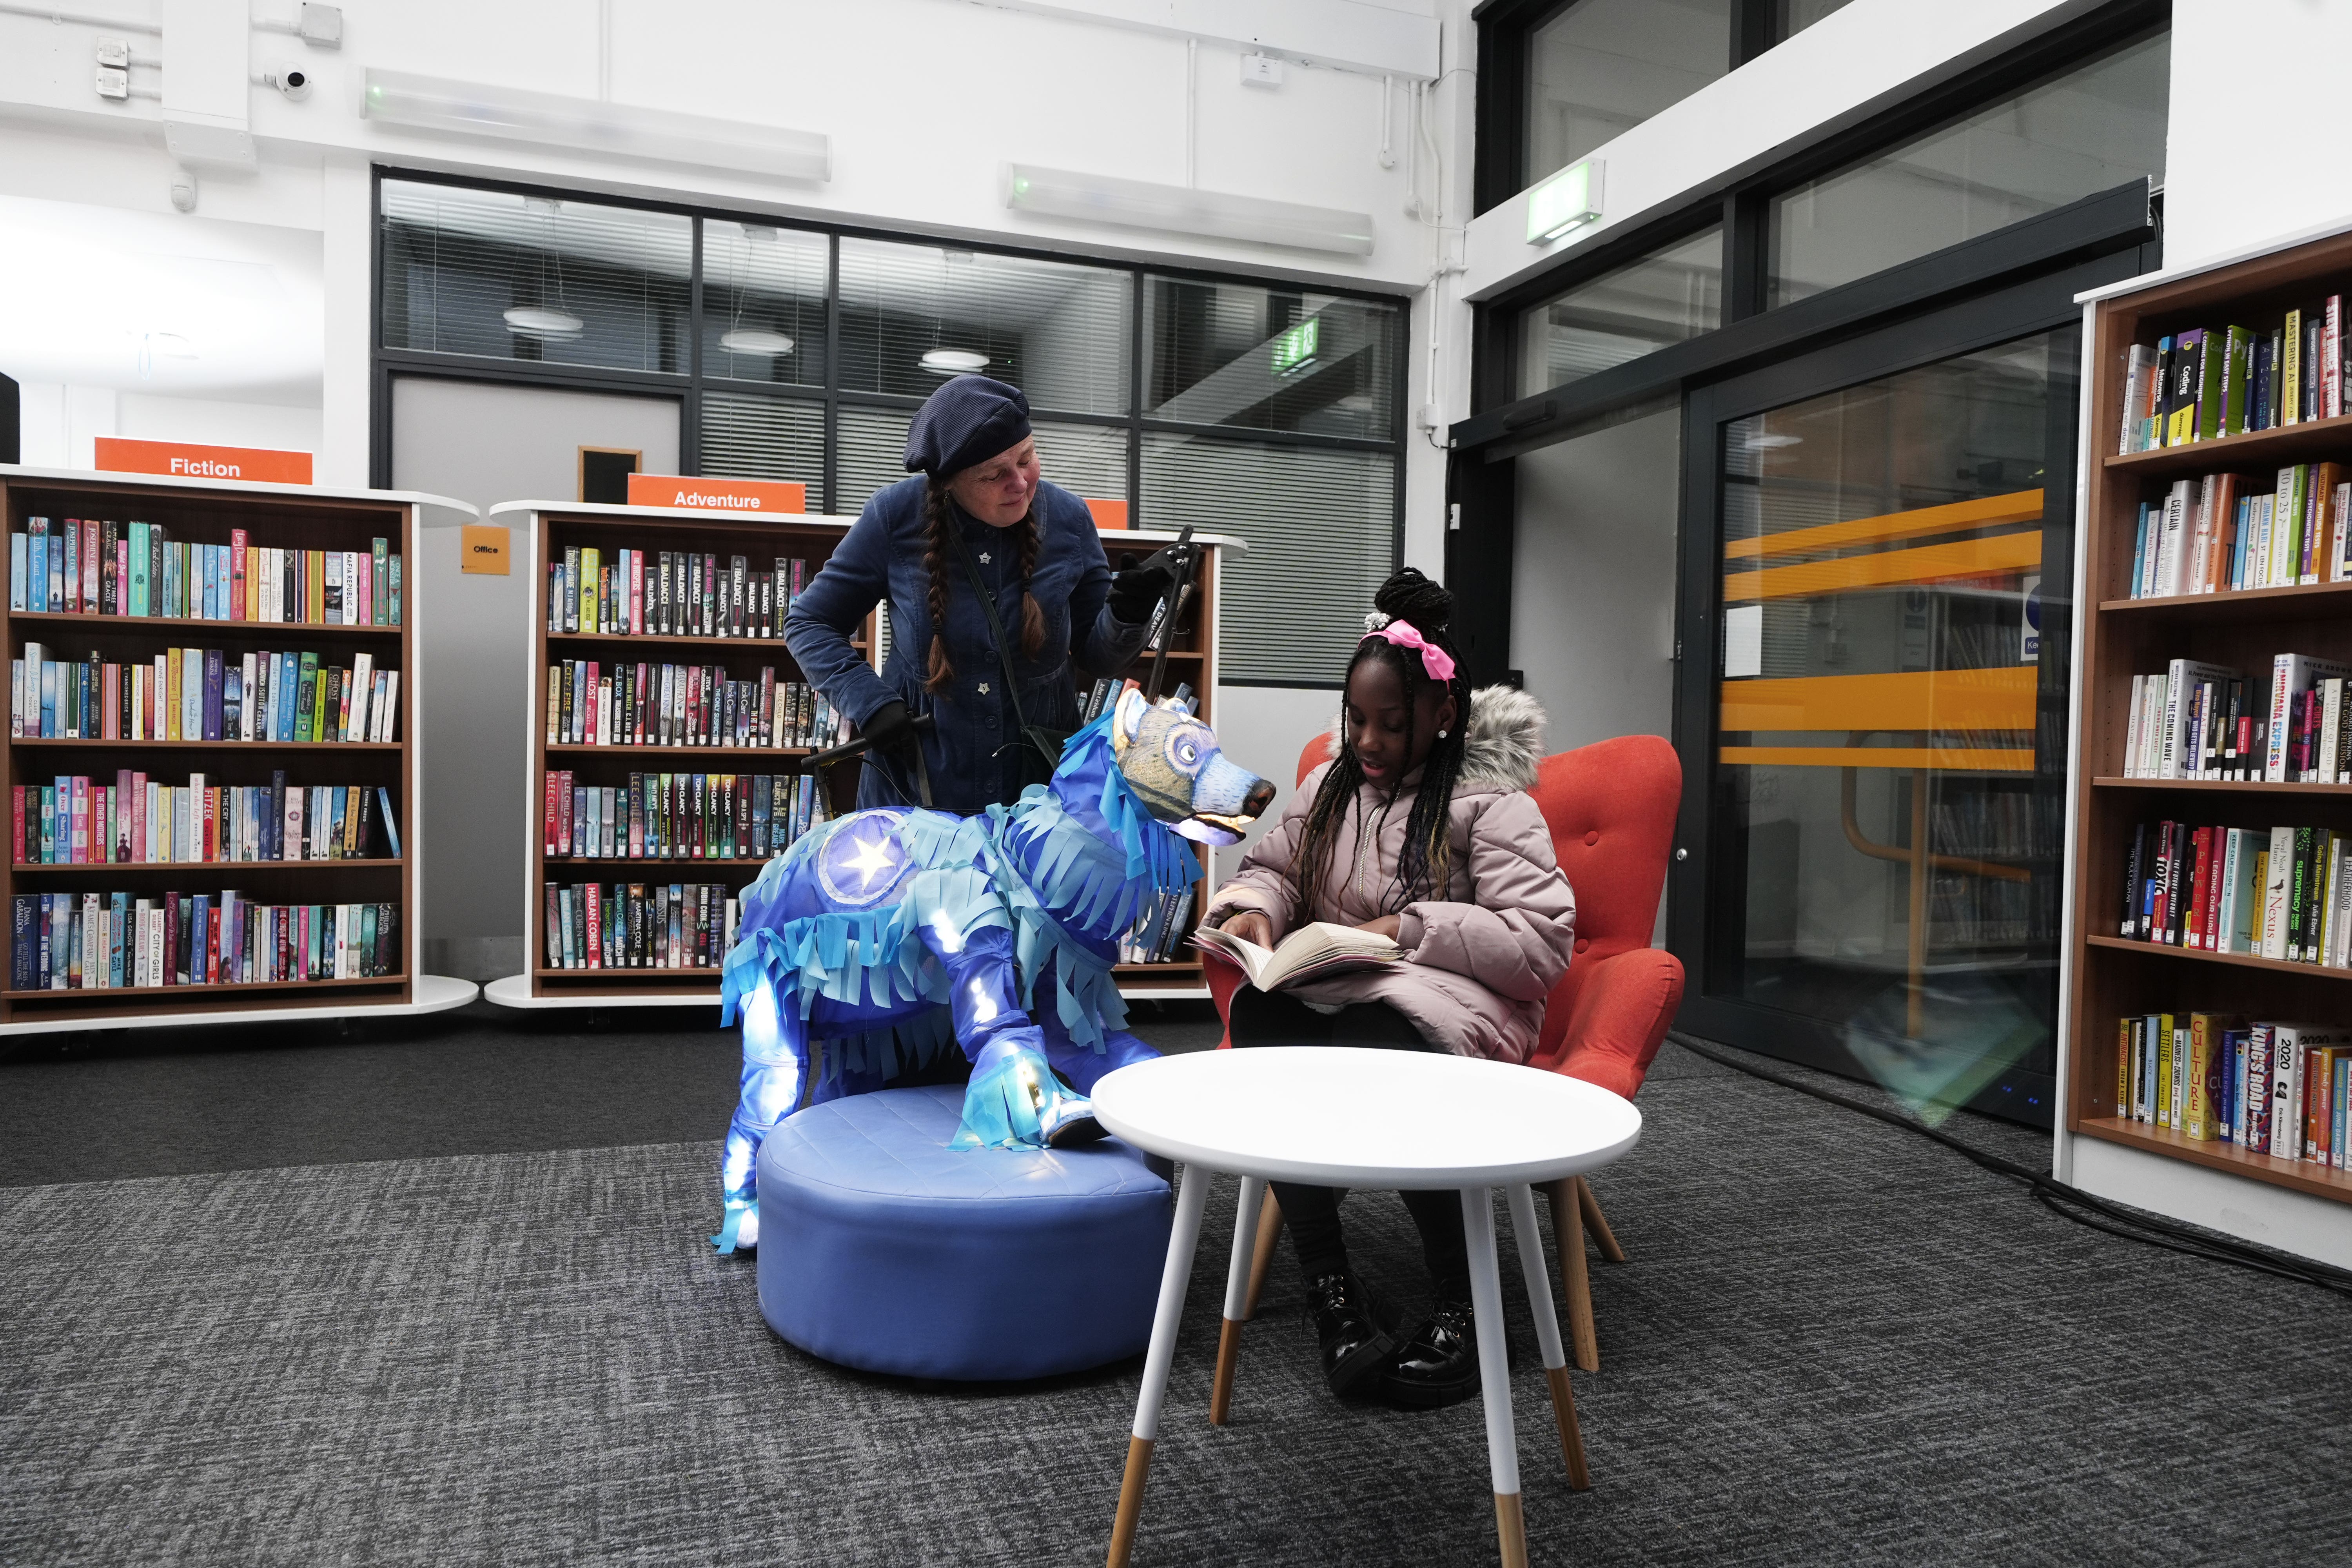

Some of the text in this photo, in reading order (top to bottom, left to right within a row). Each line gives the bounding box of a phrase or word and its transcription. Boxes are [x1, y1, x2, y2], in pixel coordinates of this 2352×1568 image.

[2179, 366, 2190, 395] Coding
[2288, 374, 2294, 383] AI
[171, 458, 240, 477] Fiction
[674, 491, 760, 508] Adventure
[2279, 473, 2290, 513] 10 to 25
[2169, 500, 2182, 531] CERTAIN
[2305, 499, 2313, 537] PSYCHOMETRIC
[331, 674, 339, 701] GHOST
[1090, 696, 1101, 717] Grisham
[2269, 674, 2286, 766] NIRVANA EXPRESS
[2312, 706, 2322, 728] CULTS
[2164, 701, 2176, 761] THE COMING WAVE
[2328, 734, 2333, 744] OF
[2188, 745, 2196, 769] BELIEVED?
[2339, 731, 2347, 770] DELUSION
[204, 790, 213, 820] FITZEK
[2278, 836, 2288, 873] Yuval Noah
[2156, 860, 2167, 894] TOXIC
[2193, 851, 2205, 916] POWER
[2210, 860, 2218, 893] LEADING
[2292, 860, 2304, 912] supremacy
[2313, 845, 2324, 900] Going Mainstream
[2341, 861, 2352, 910] FEATHERHOOD
[588, 887, 597, 950] HARLAN COBEN
[2267, 896, 2283, 938] Nexus
[2160, 1030, 2169, 1062] SETTLERS
[2280, 1039, 2291, 1070] 2020
[2191, 1021, 2203, 1111] CULTURE
[2249, 1027, 2266, 1111] KING'S ROAD
